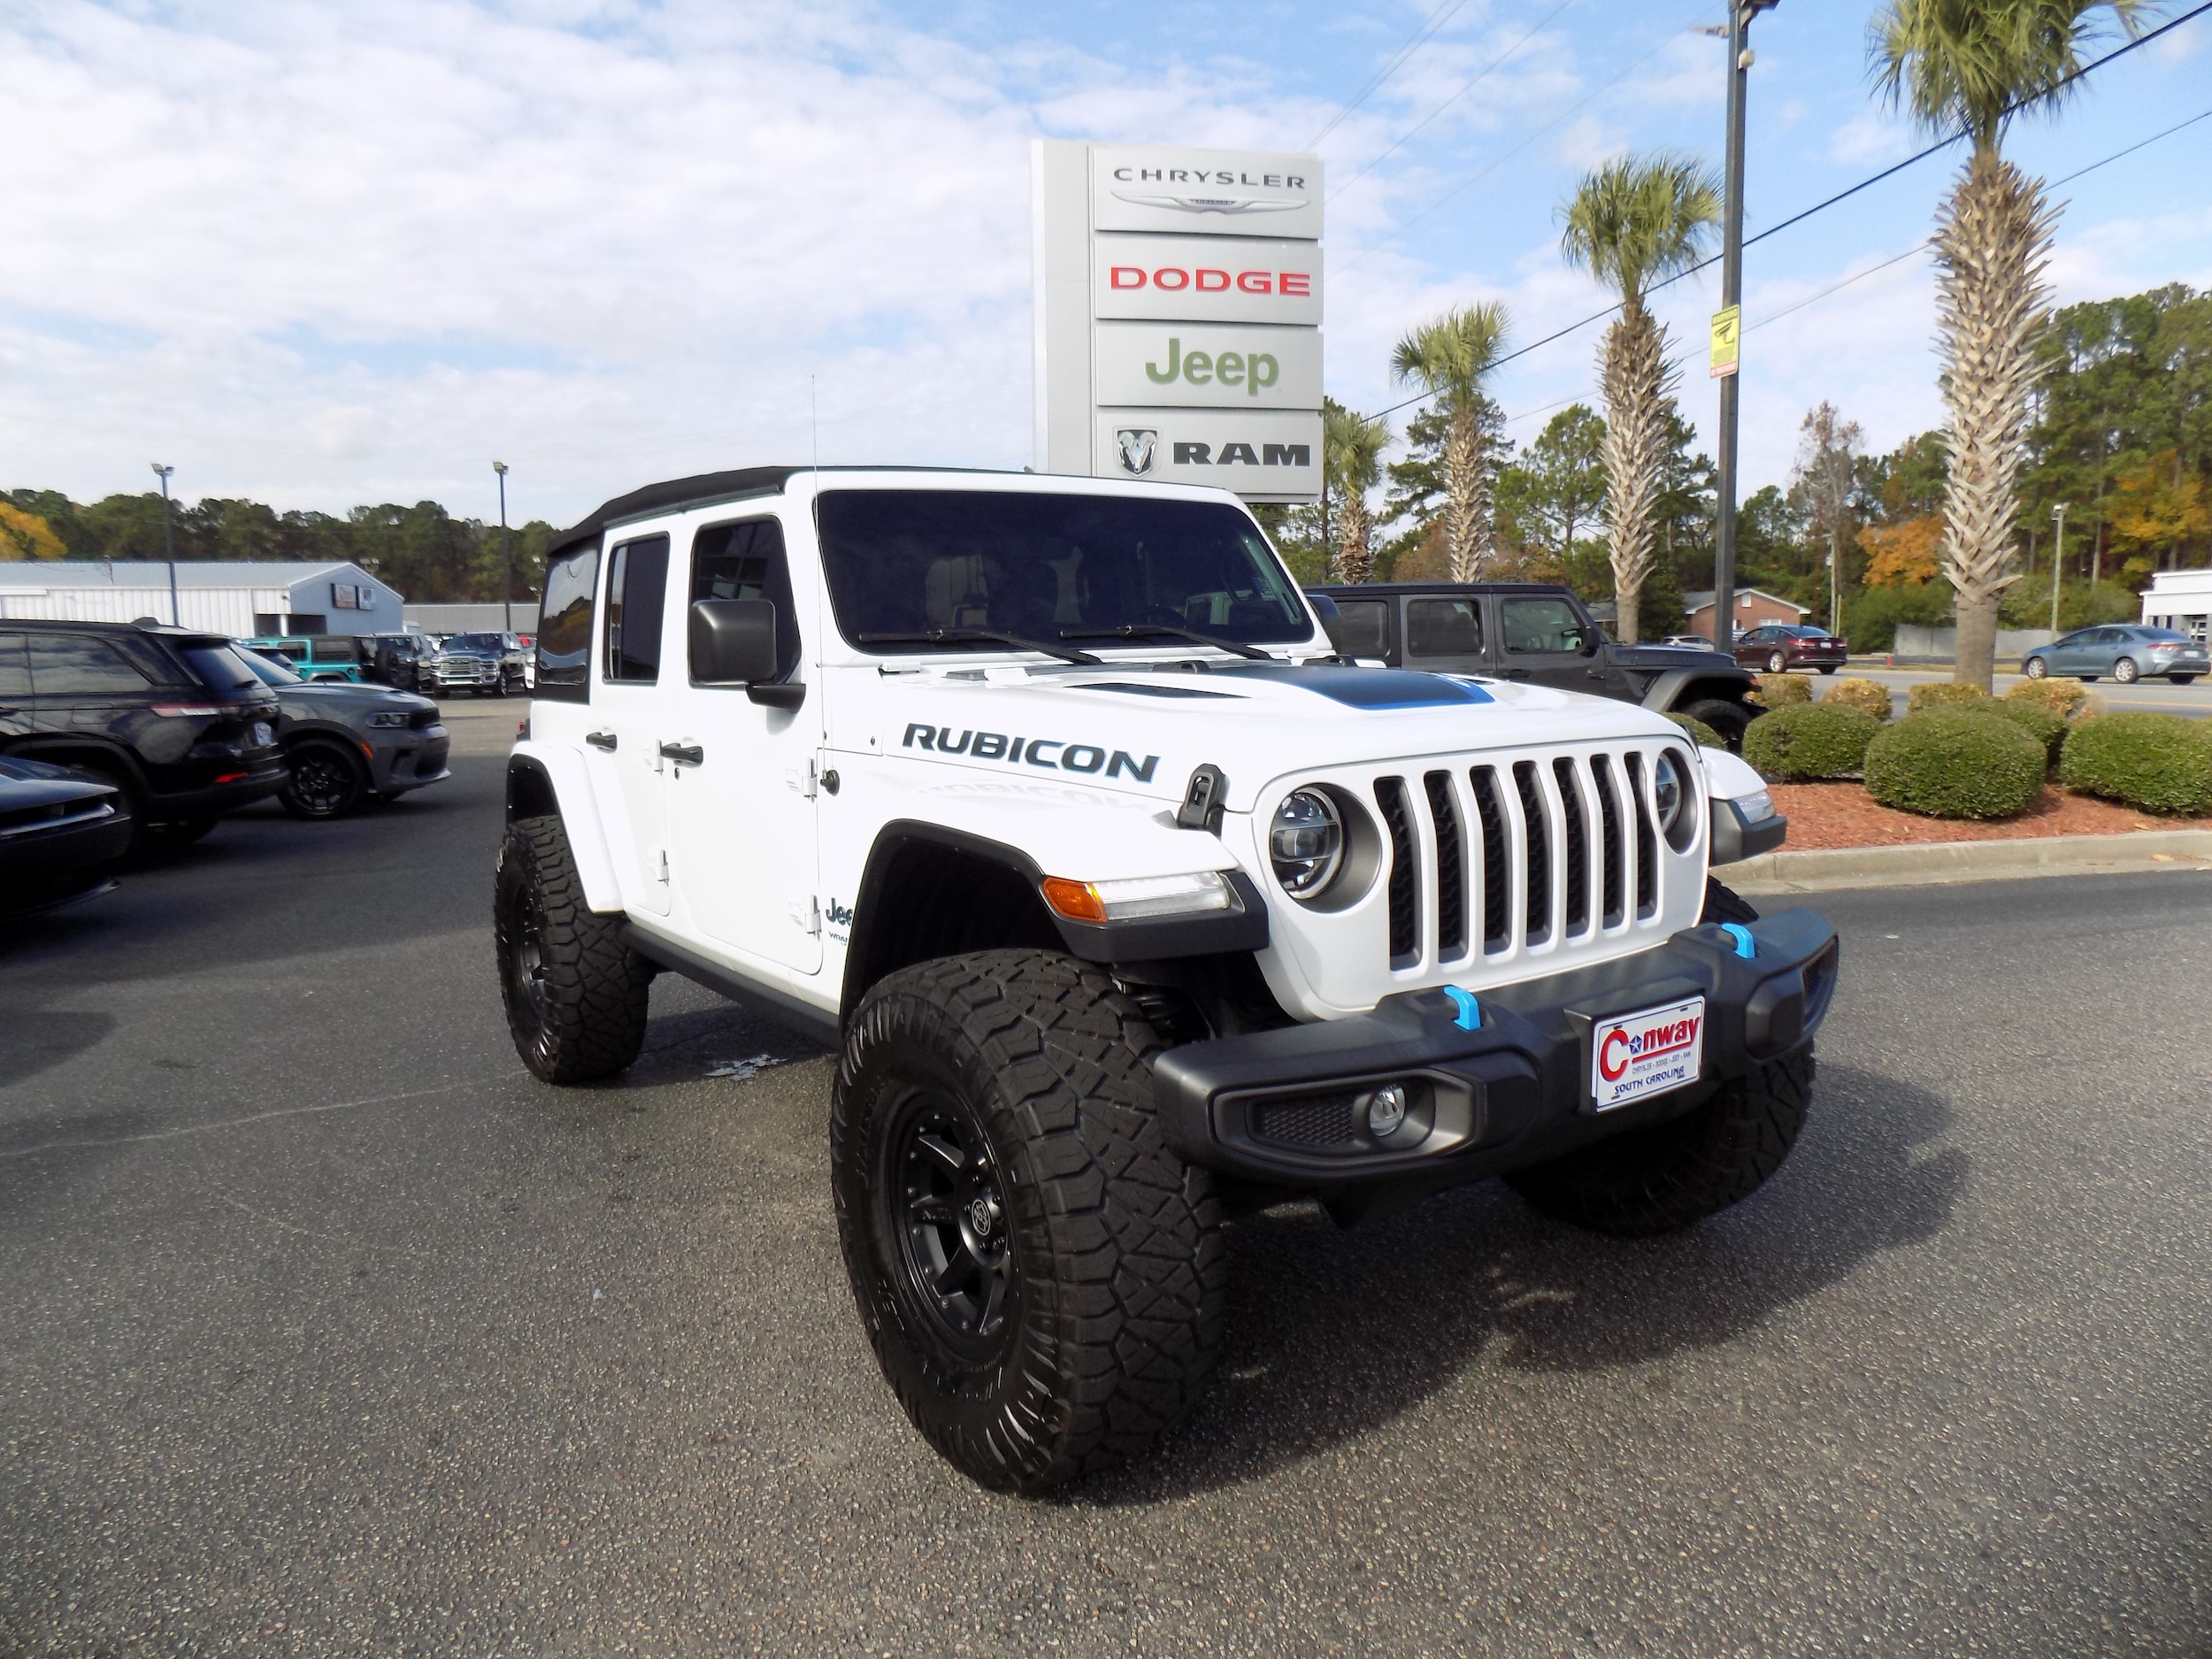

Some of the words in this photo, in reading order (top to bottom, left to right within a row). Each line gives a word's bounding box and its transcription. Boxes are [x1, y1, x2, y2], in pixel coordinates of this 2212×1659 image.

[1113, 168, 1306, 189] CHRYSLER
[1110, 266, 1310, 296] DODGE
[1145, 338, 1279, 396] Jeep
[1173, 442, 1310, 466] RAM
[902, 722, 1161, 784] RUBICON
[826, 897, 853, 927] Jee
[1614, 1079, 1643, 1094] SOUTH
[1646, 1065, 1685, 1085] CAROLINA
